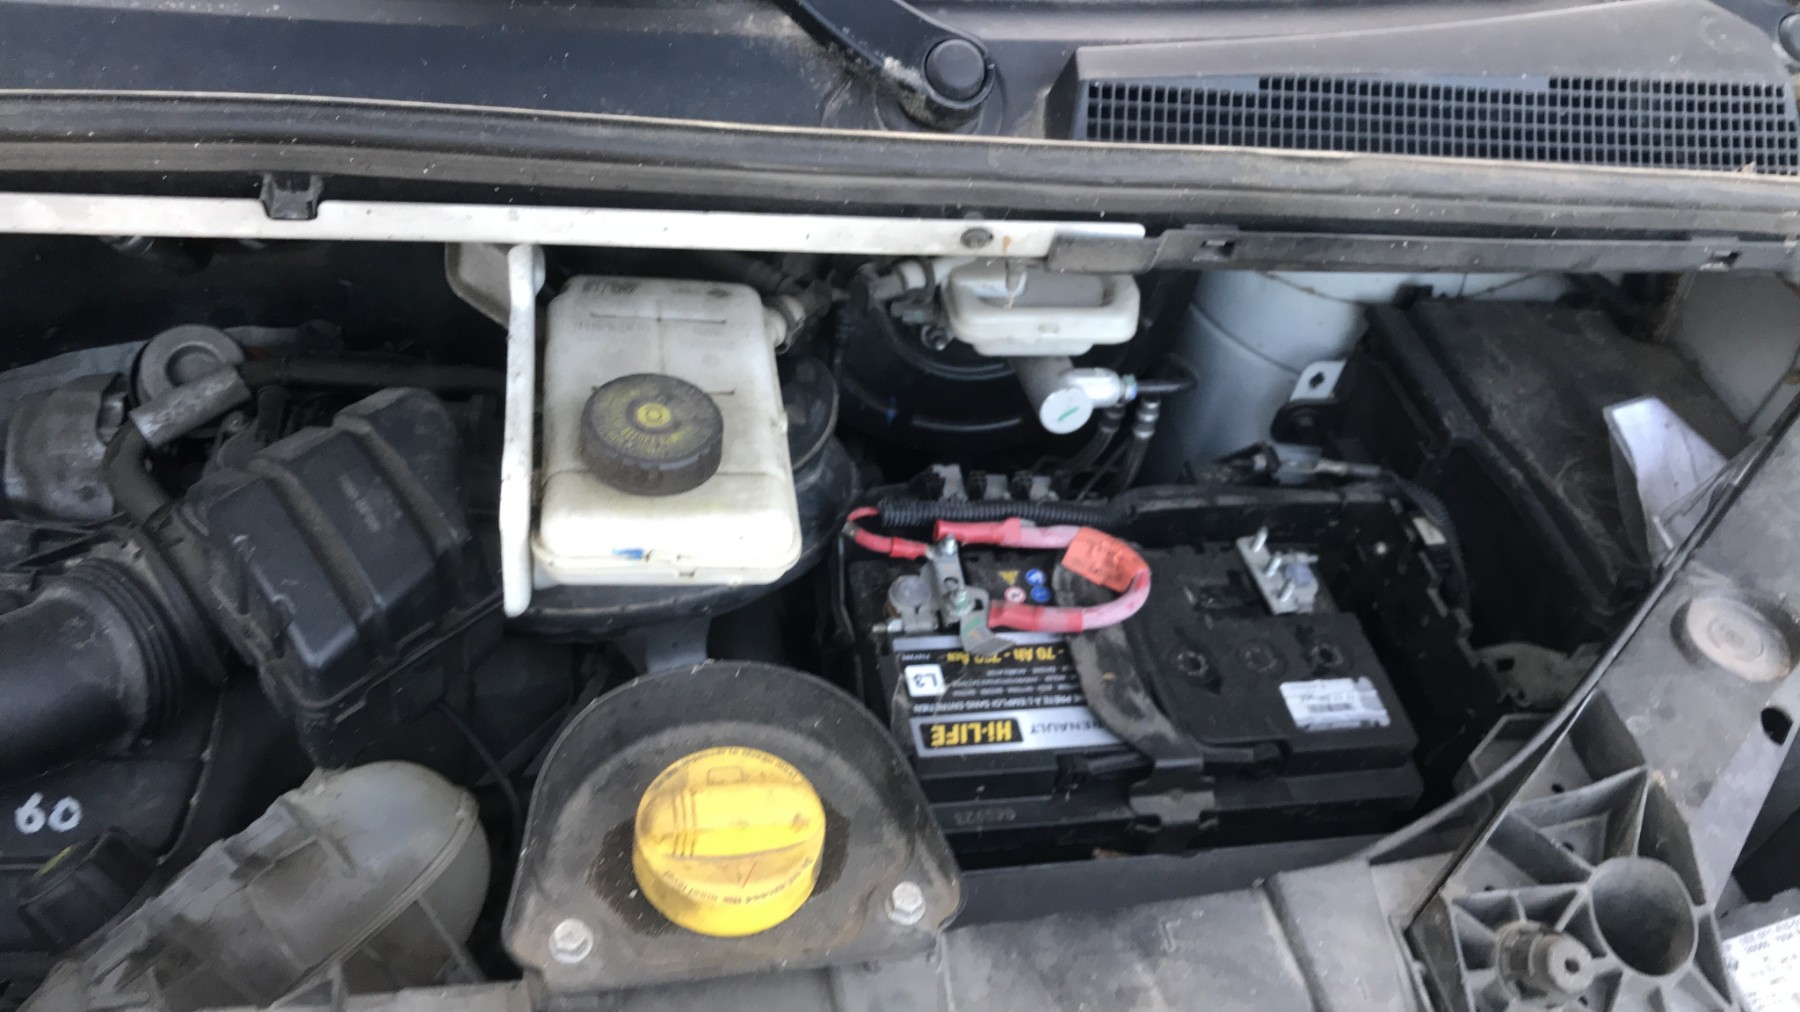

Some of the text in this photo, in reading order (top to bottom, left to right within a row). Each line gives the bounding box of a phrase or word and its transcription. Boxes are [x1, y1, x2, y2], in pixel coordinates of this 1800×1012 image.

[1013, 647, 1034, 662] Ah
[1036, 646, 1057, 661] 70
[913, 672, 938, 688] L3
[14, 791, 82, 835] 60
